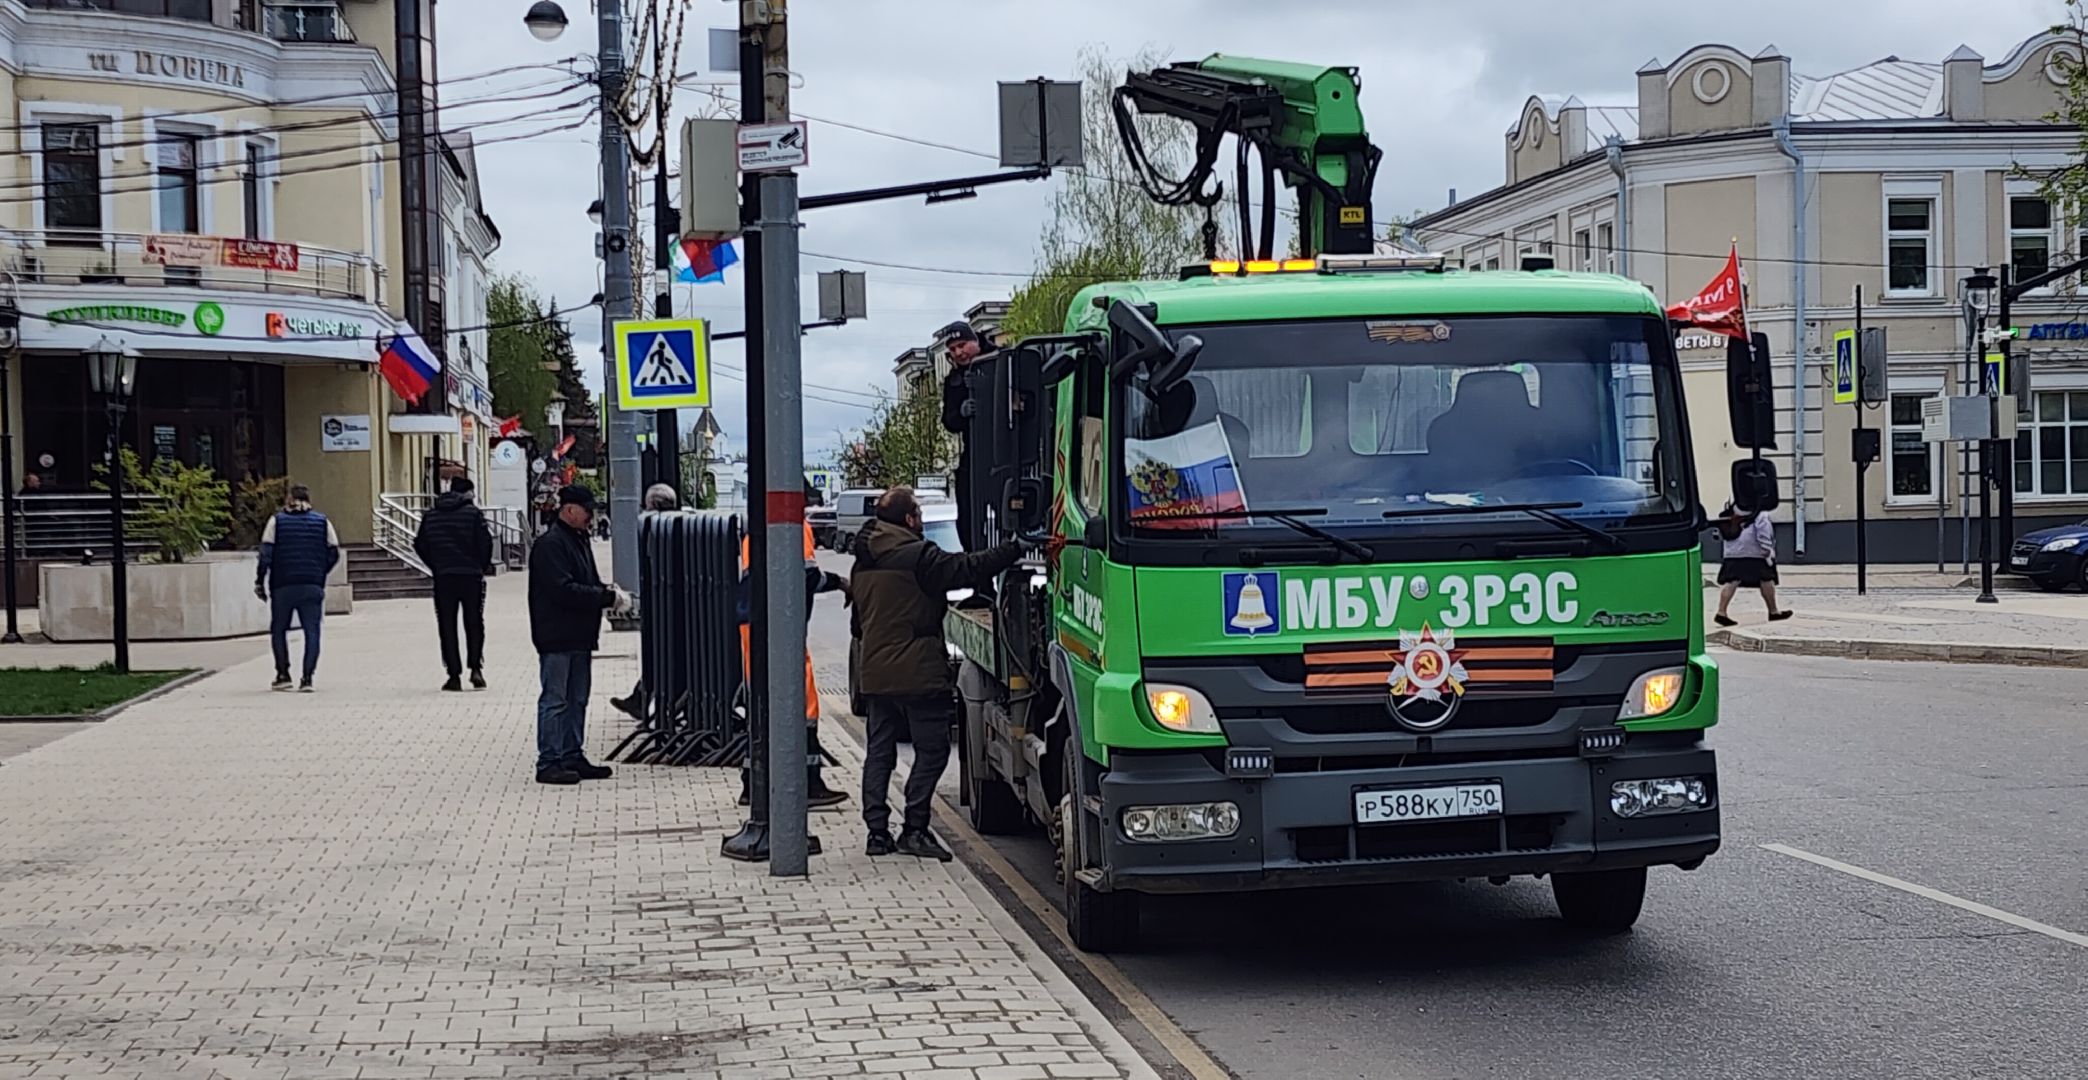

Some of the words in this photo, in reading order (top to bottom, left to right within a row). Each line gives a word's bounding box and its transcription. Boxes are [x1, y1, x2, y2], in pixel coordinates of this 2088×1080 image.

[135, 50, 244, 88] ПОБЕДА
[1285, 575, 1404, 630] МБУ
[1438, 571, 1578, 628] ЗРЭС
[1460, 789, 1496, 808] 750
